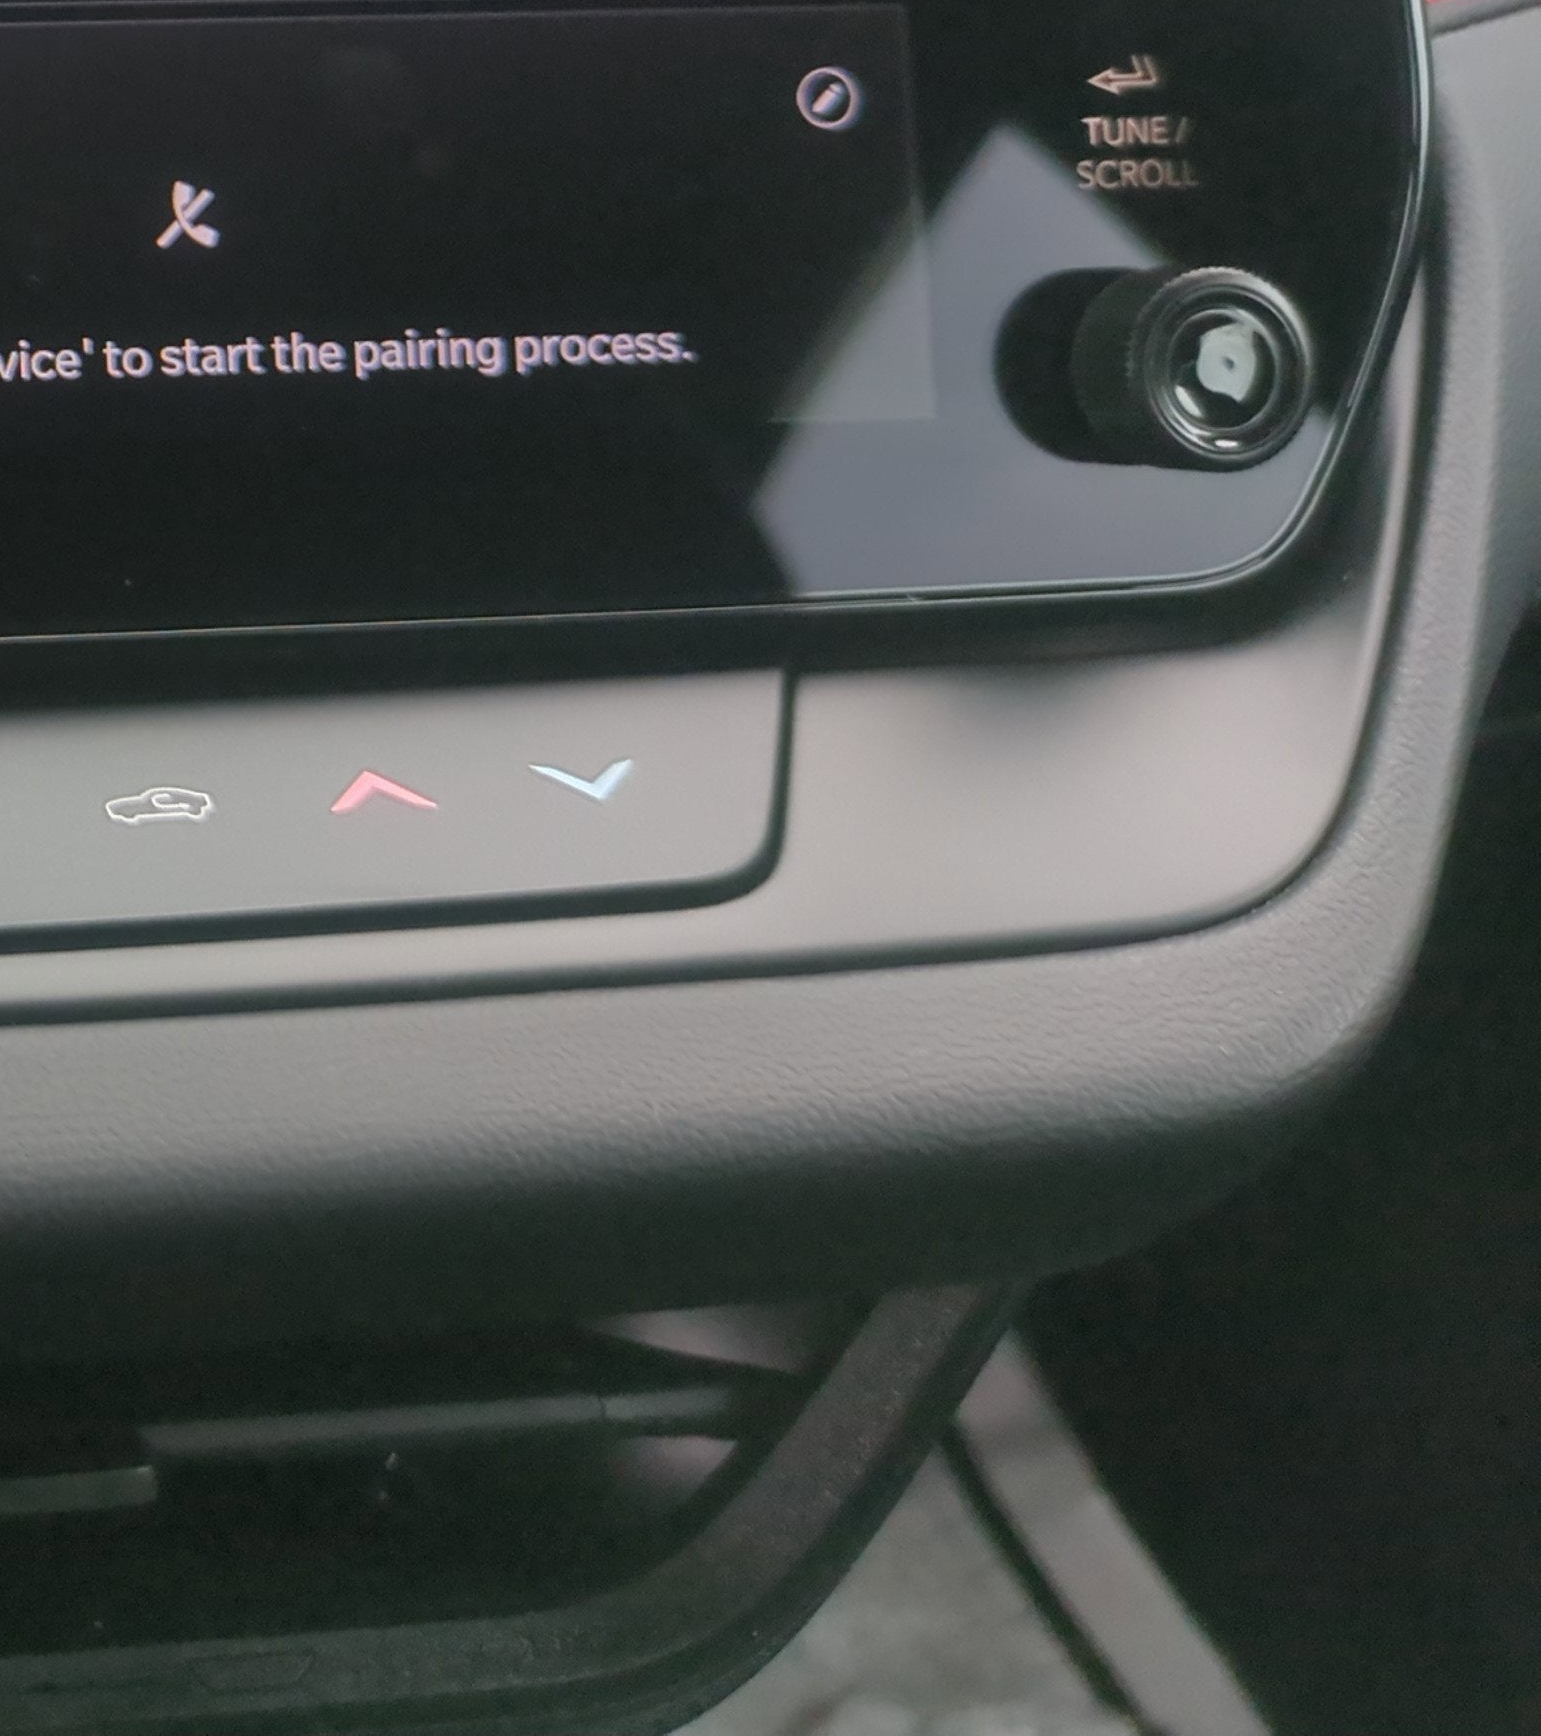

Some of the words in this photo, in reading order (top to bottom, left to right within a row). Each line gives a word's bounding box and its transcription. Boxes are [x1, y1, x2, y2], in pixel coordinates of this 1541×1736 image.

[1075, 160, 1198, 190] SCROLL
[103, 340, 153, 380] to
[158, 336, 265, 377] start
[271, 331, 346, 373] the
[354, 327, 505, 381] pairing
[514, 330, 696, 377] process.
